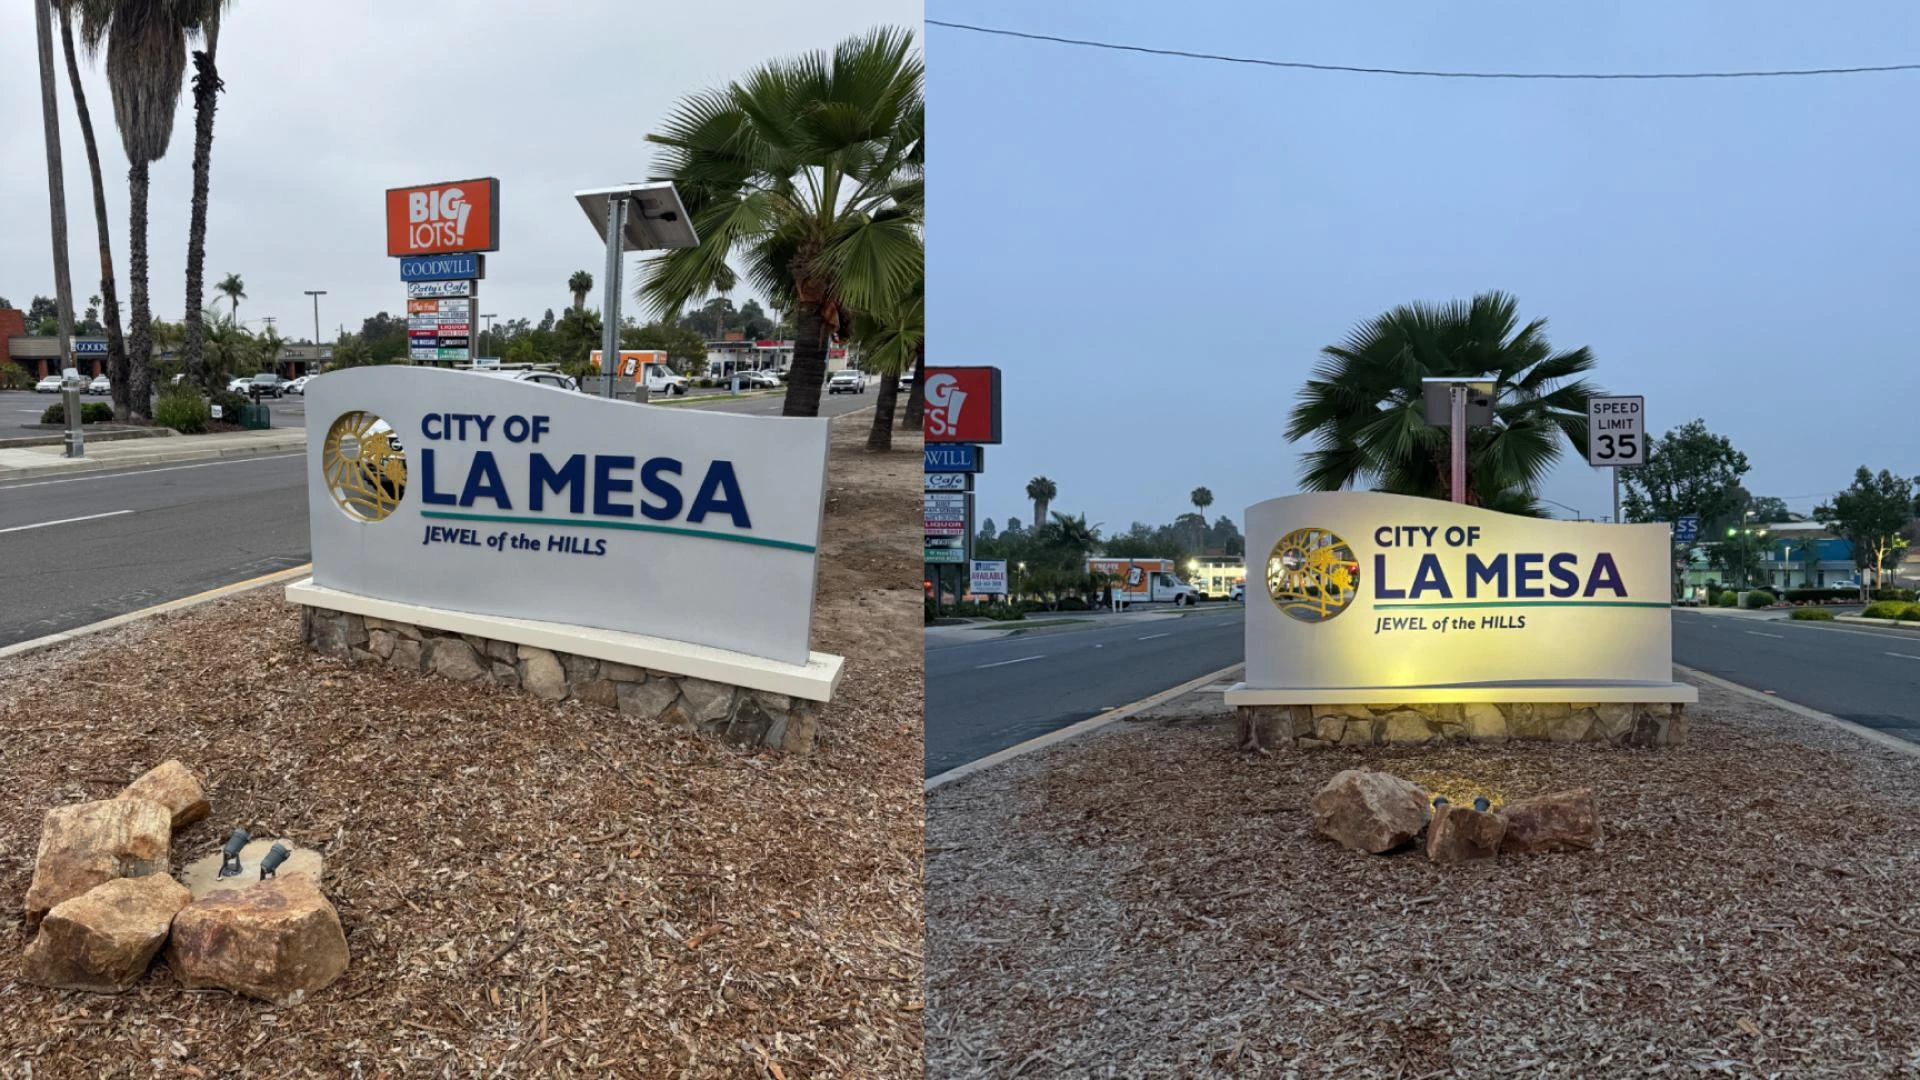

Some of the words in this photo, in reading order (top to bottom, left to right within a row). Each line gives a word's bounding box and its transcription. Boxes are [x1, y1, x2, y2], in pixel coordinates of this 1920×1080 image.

[409, 188, 466, 223] BIG
[409, 203, 472, 249] LOTS!
[402, 259, 474, 277] GOODWILL
[1593, 402, 1639, 414] SPEED
[421, 413, 496, 442] CITY
[503, 415, 549, 443] OF
[1598, 418, 1634, 430] LIMIT
[924, 450, 971, 466] WILL
[1597, 434, 1637, 459] 35
[421, 448, 513, 511] LA
[529, 453, 752, 529] MESA
[929, 474, 962, 486] Cafe
[423, 525, 481, 546] JEWEL
[487, 532, 507, 551] of
[511, 533, 541, 551] the
[547, 535, 606, 556] HILLS
[1374, 526, 1438, 547] CITY
[1445, 526, 1480, 547] OF
[1374, 553, 1453, 599] LA
[1466, 552, 1628, 598] MESA
[1374, 617, 1427, 634] JEWEL
[1432, 616, 1450, 633] of
[1452, 616, 1476, 630] the
[1481, 615, 1526, 629] HILLS
